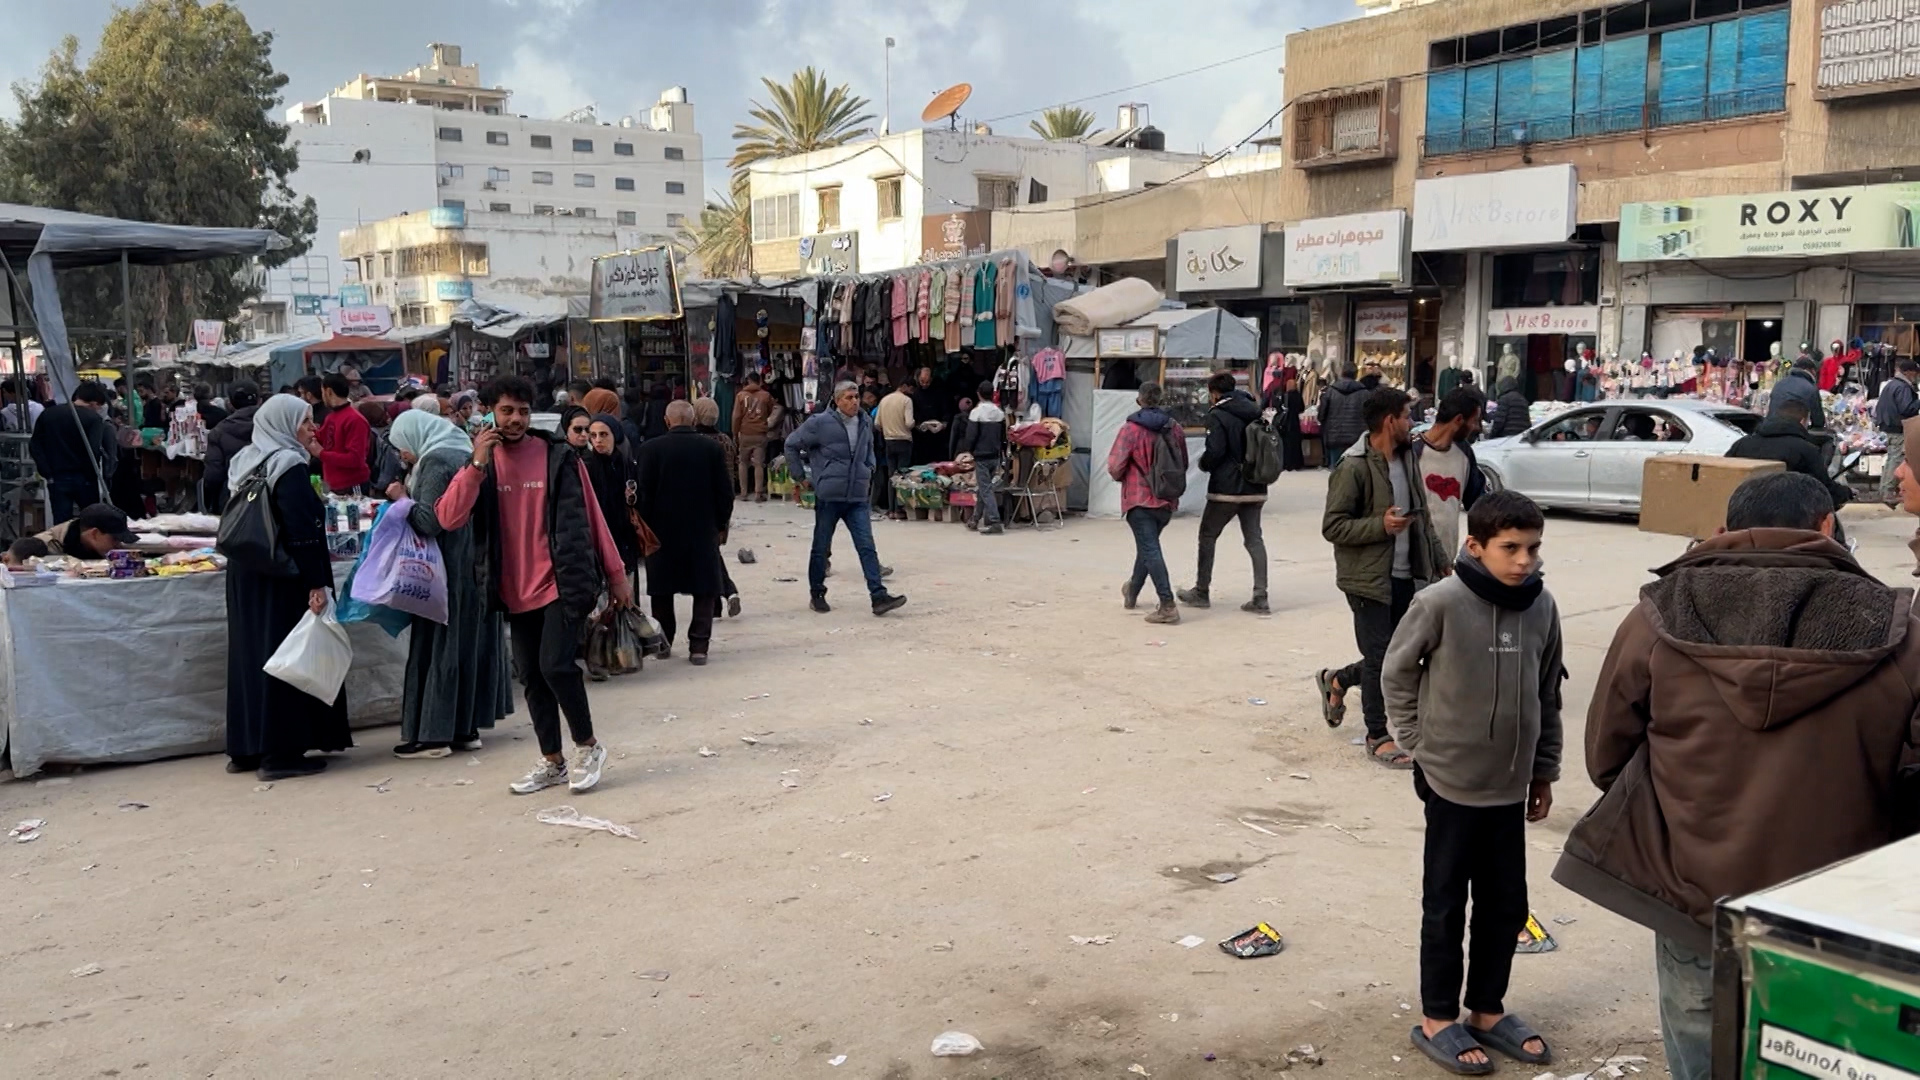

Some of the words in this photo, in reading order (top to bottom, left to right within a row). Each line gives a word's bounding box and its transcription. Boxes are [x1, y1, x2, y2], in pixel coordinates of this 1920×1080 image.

[1740, 195, 1853, 226] ROXY
[1296, 233, 1324, 252] مطير
[1326, 229, 1384, 247] مجوهرات
[1187, 245, 1245, 281] حكاية
[1553, 318, 1588, 328] store
[1765, 1037, 1842, 1076] younger
